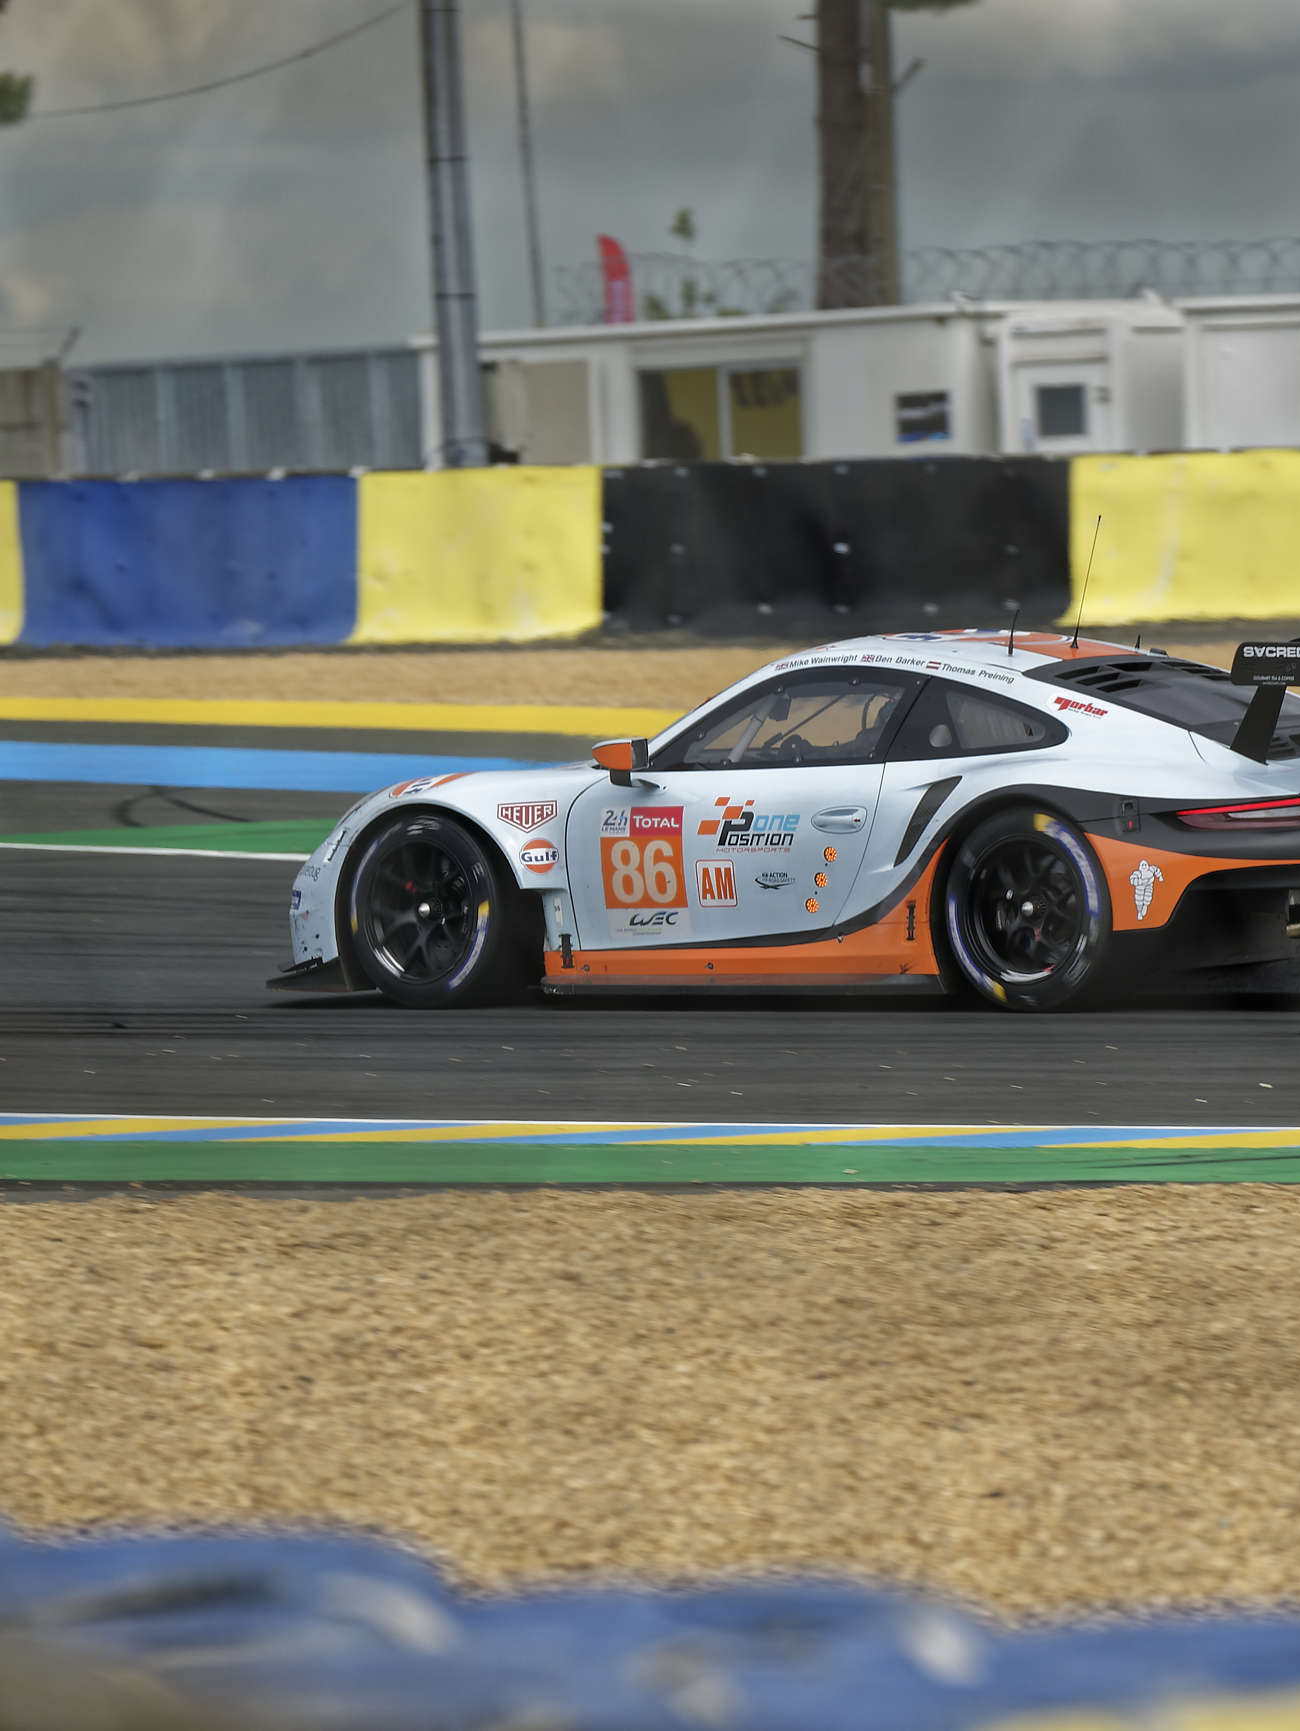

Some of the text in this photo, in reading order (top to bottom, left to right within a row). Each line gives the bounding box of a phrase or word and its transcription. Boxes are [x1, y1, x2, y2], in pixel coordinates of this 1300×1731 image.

[789, 654, 858, 668] Mike Wainwright
[895, 656, 925, 667] Barker
[942, 663, 1015, 684] Thomas Preining
[501, 805, 553, 828] HEUER
[633, 815, 680, 828] TOTAL
[521, 850, 558, 863] Gulf
[611, 839, 677, 904] 86
[702, 867, 735, 900] AM
